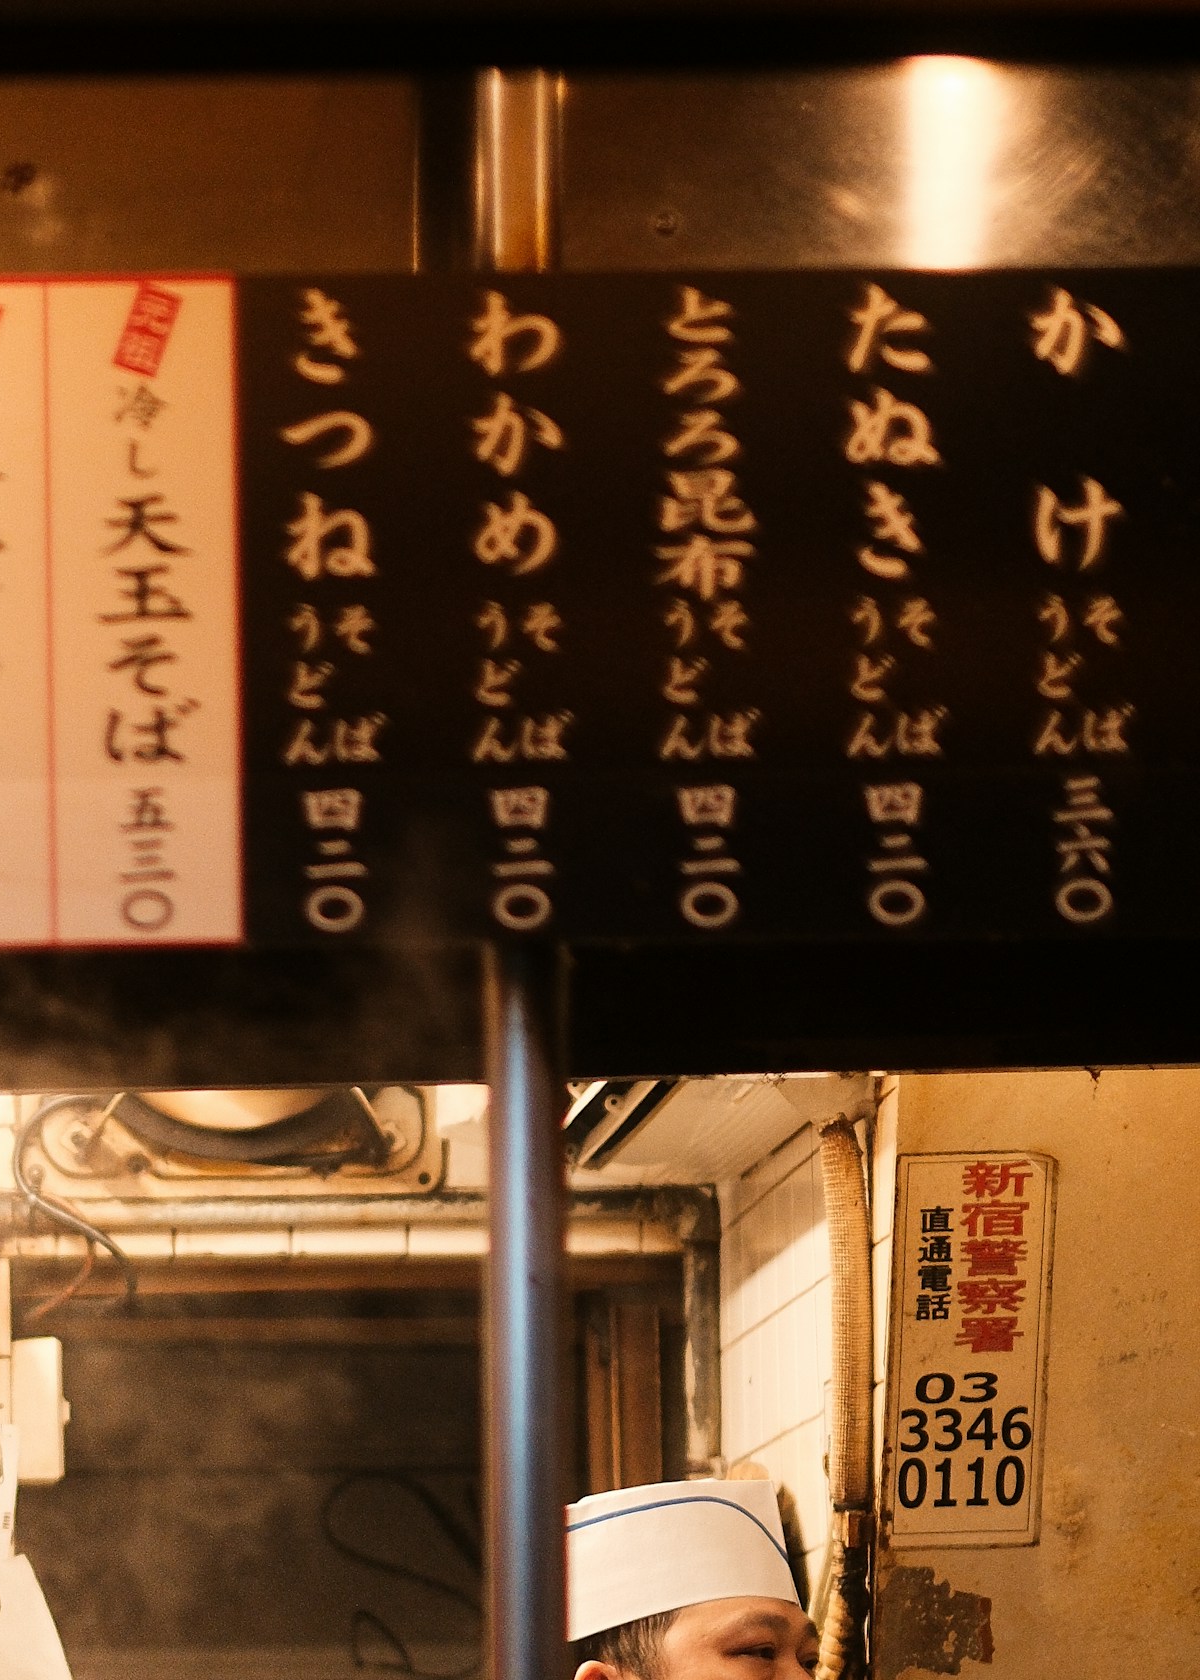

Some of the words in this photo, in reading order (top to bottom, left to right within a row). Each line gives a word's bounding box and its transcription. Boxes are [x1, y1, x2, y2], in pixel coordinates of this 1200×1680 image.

[282, 288, 376, 580] きつね
[469, 290, 565, 575] わかめ
[655, 287, 756, 597] とろろ昆布
[846, 284, 942, 578] たぬき
[1031, 287, 1125, 569] かけ
[286, 604, 331, 764] うどん
[333, 605, 388, 764] そば
[472, 601, 519, 762] うどん
[521, 603, 574, 762] そば
[660, 599, 706, 760] うどん
[709, 600, 760, 760] そば
[847, 597, 894, 758] うどん
[896, 598, 949, 756] そば
[1035, 595, 1081, 756] うどん
[1083, 596, 1136, 754] そば
[916, 1206, 954, 1321] 直通電話
[955, 1160, 1033, 1354] 新宿警察署
[900, 1406, 1032, 1453] 3346
[915, 1372, 999, 1404] 03
[898, 1455, 1026, 1509] 0110
